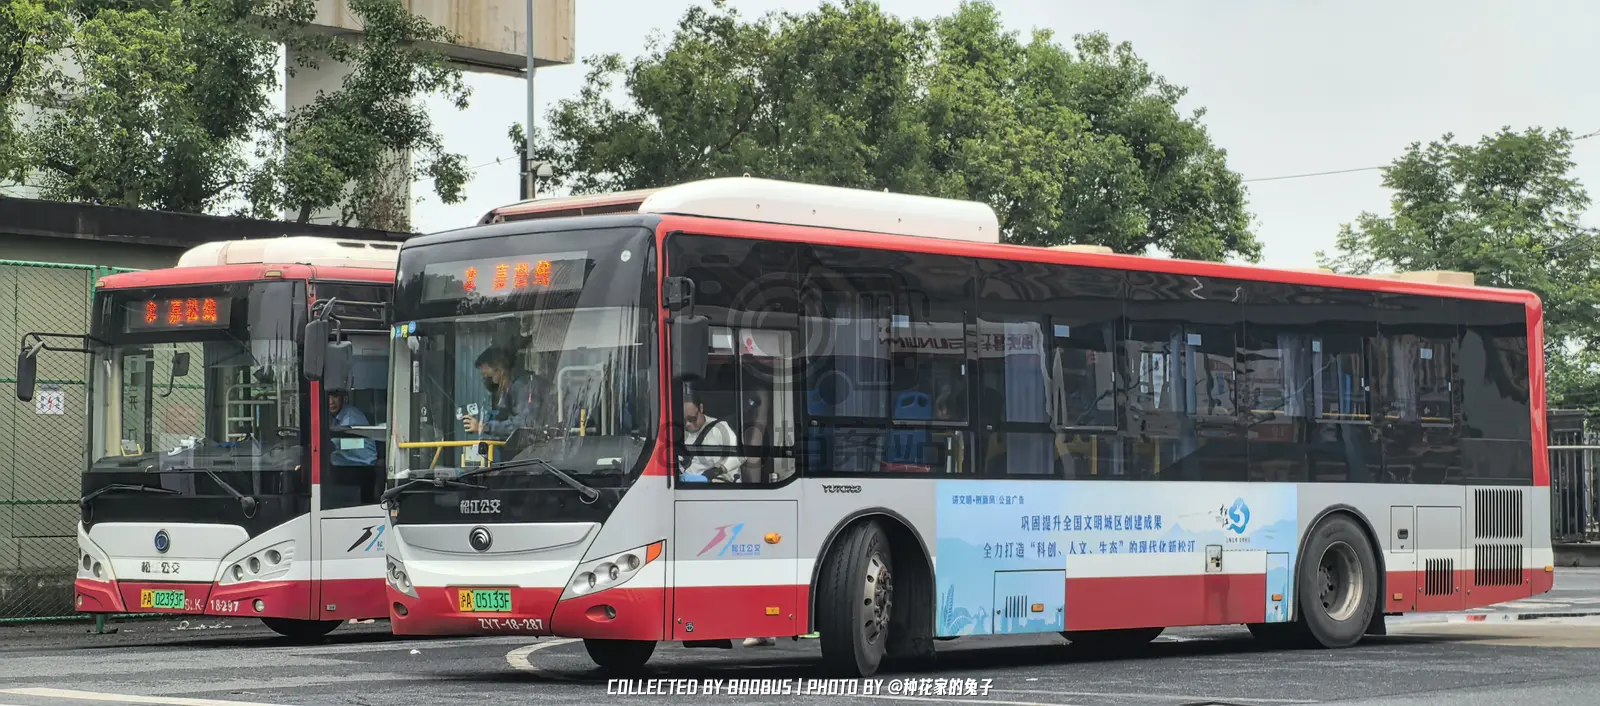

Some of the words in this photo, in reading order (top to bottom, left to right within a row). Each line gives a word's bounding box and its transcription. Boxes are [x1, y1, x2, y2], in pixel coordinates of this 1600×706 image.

[460, 499, 501, 514] 松江公交
[1021, 514, 1162, 531] 巩固提升全国文明城区创建成果
[141, 561, 180, 574] 松公交
[478, 618, 543, 630] ZYT-18-287
